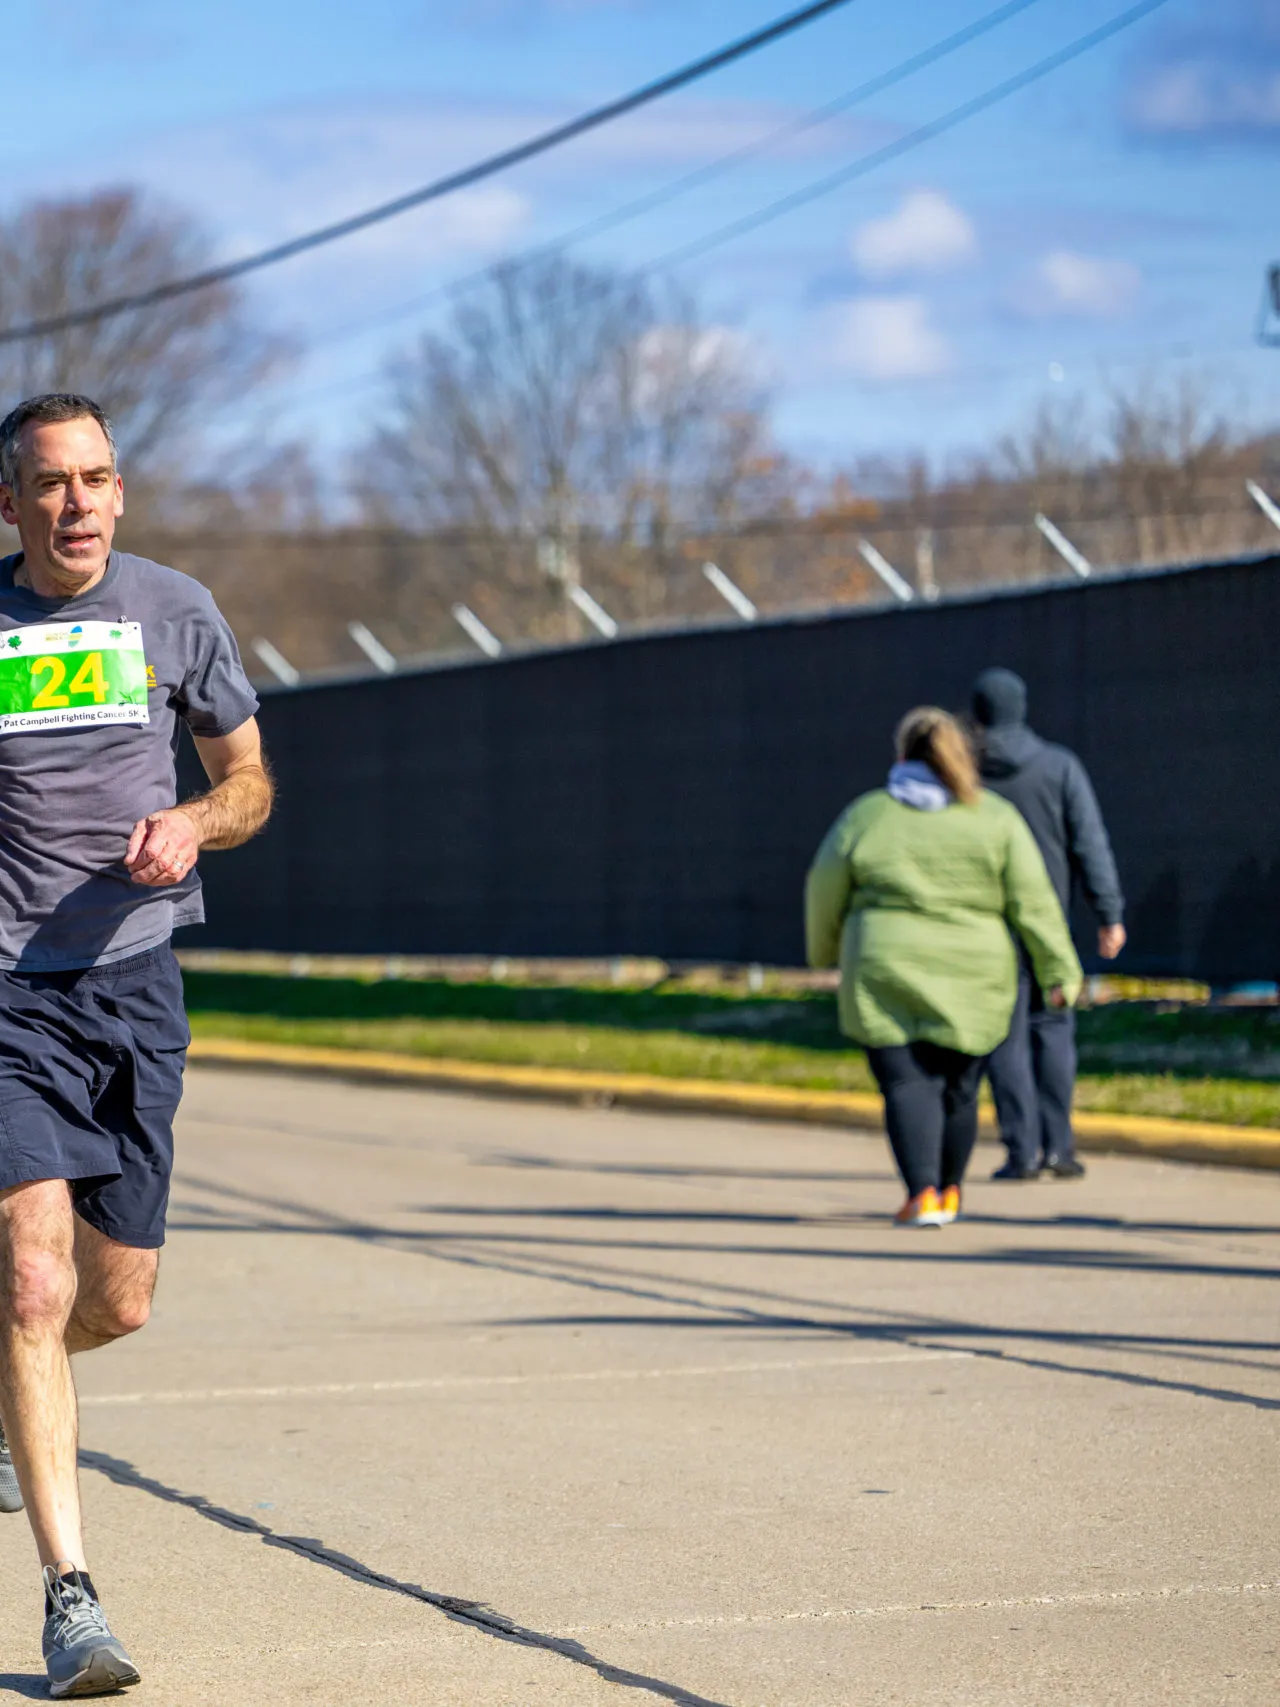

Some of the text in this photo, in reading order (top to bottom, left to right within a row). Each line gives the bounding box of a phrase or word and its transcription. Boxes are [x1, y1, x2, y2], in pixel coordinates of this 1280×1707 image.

[31, 652, 109, 708] 24
[4, 709, 139, 727] Pat Campbell Fighting Cancer 5K
